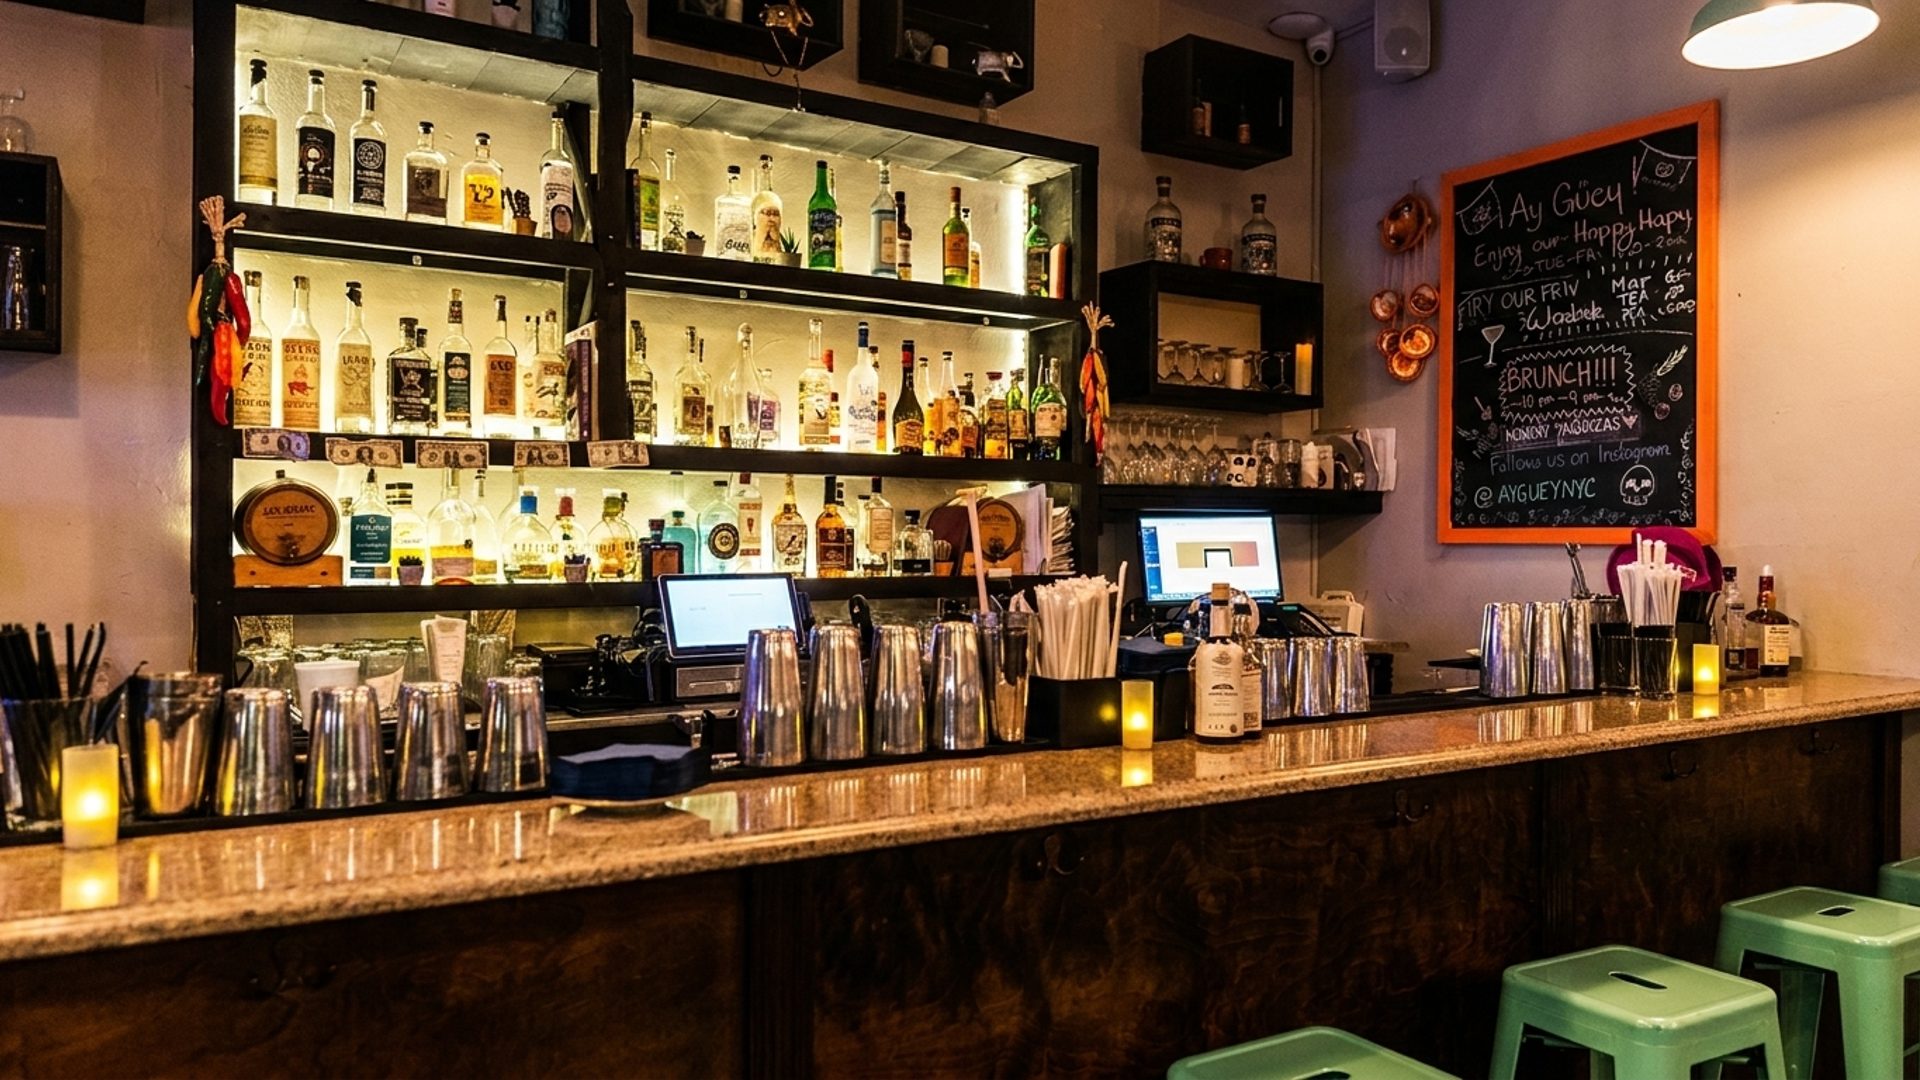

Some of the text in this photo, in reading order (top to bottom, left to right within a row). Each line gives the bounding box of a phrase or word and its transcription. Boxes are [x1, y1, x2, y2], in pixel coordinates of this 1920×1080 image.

[1508, 192, 1543, 233] Ay
[1500, 286, 1536, 310] OUR
[1506, 356, 1617, 393] BRUNCH!!!
[1546, 453, 1565, 469] us
[1570, 451, 1589, 466] on
[1497, 476, 1597, 505] AYGUEYNYC
